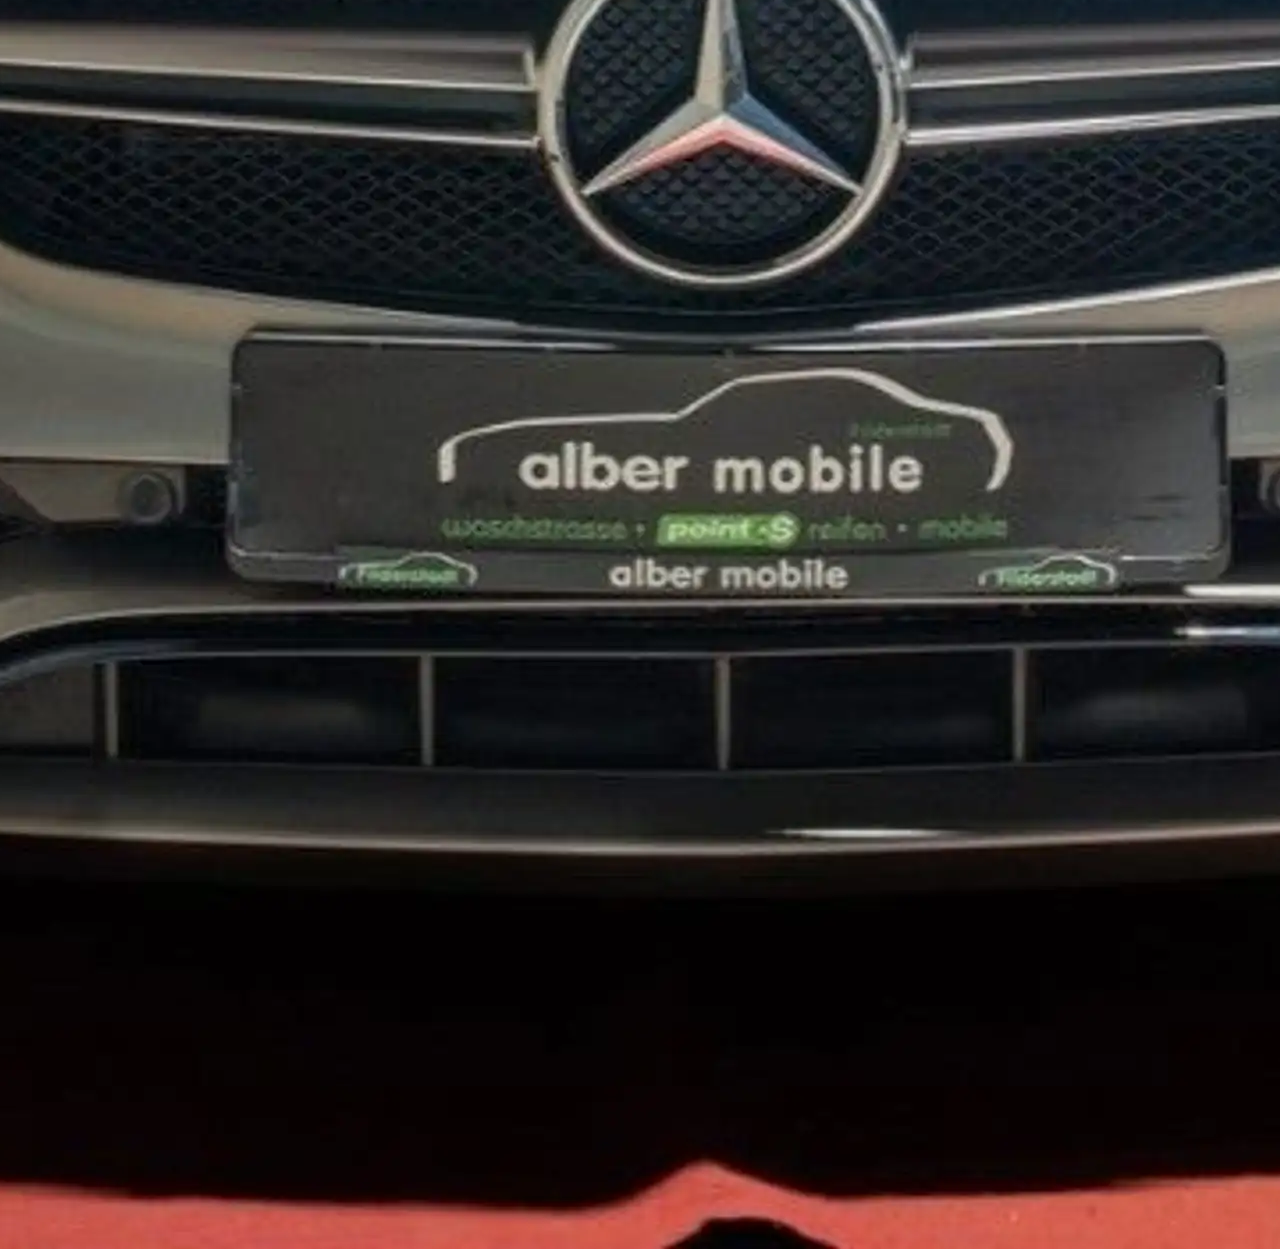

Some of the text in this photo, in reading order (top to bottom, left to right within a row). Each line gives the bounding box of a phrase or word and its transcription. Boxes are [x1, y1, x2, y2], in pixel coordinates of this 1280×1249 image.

[519, 441, 924, 493] alber mobile
[609, 557, 849, 590] alber mobile
